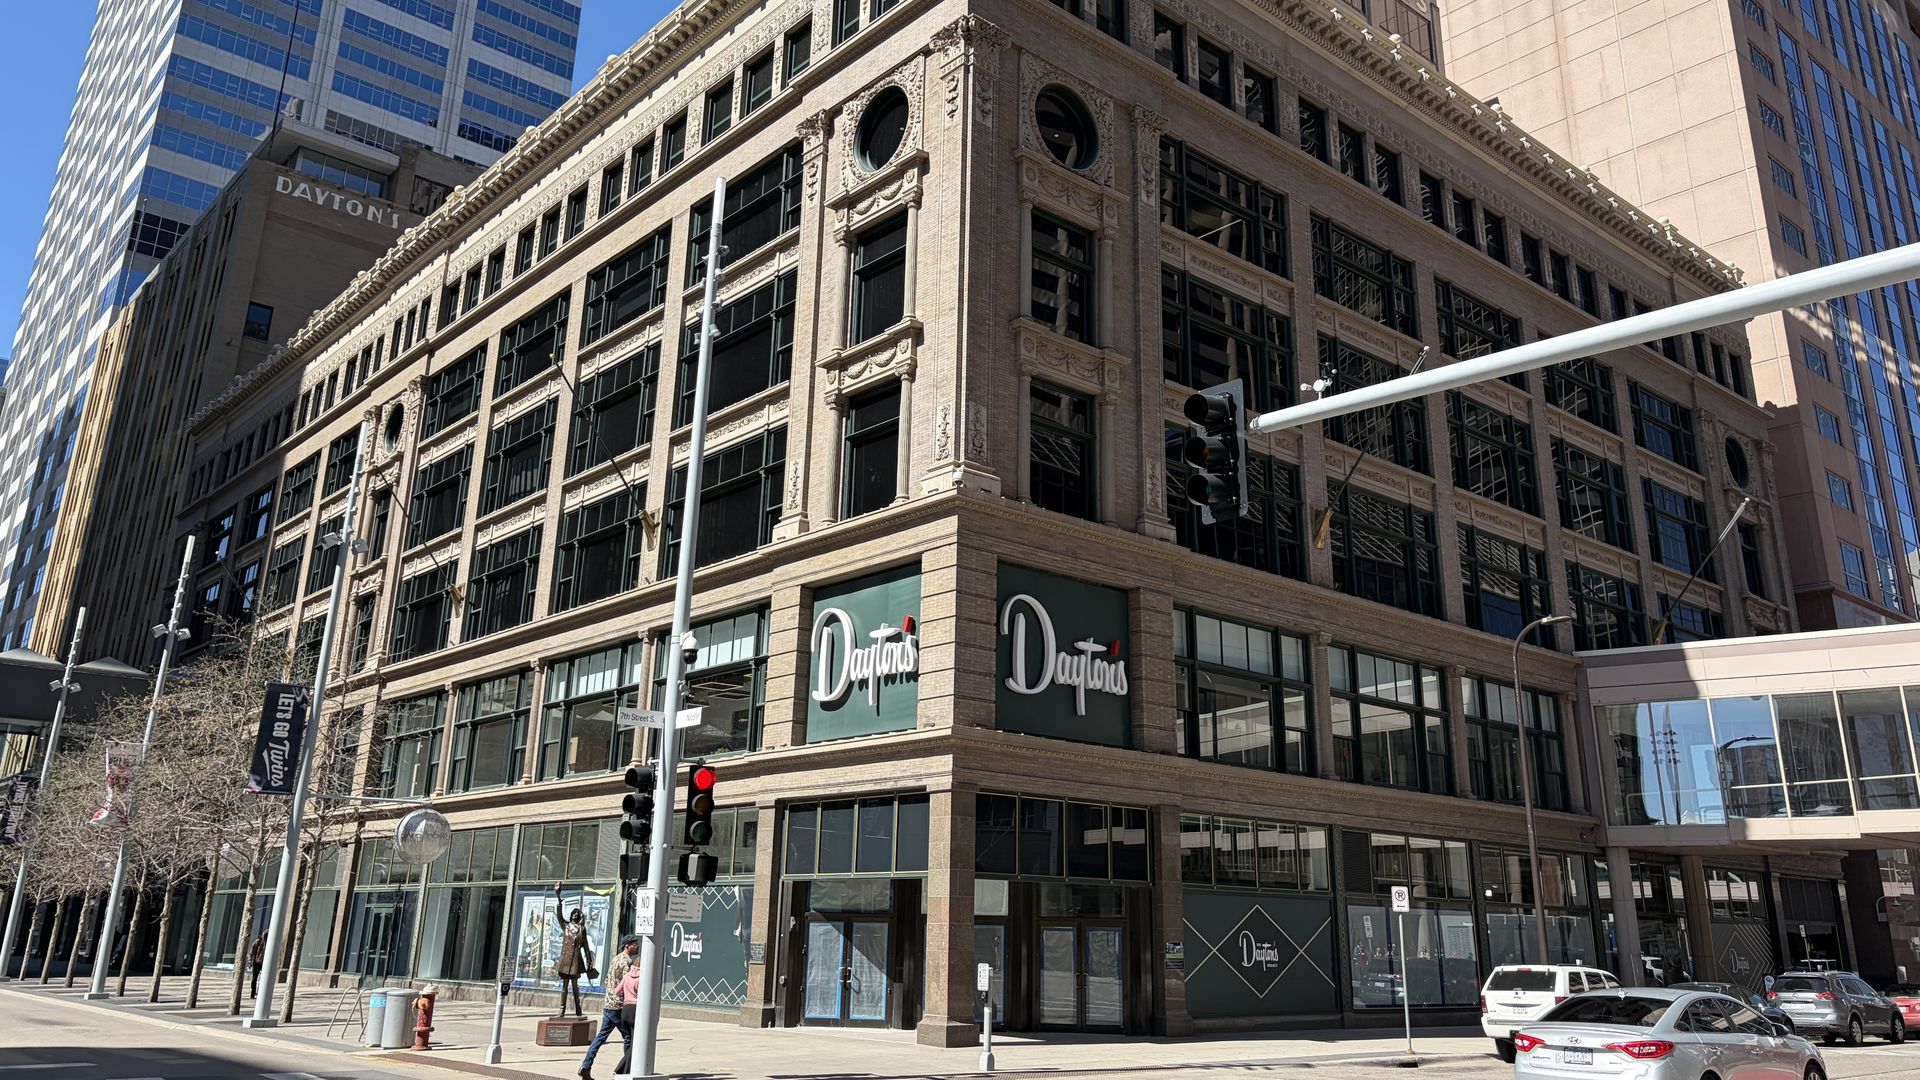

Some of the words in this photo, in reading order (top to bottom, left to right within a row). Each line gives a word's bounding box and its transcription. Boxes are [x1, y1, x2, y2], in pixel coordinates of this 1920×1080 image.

[275, 175, 400, 229] DAYTON'S
[811, 607, 919, 706] Dayton's
[1000, 594, 1128, 716] Dayton's
[275, 692, 295, 719] LET'S
[620, 711, 631, 720] 7th
[631, 713, 650, 723] Street
[272, 721, 291, 738] GO
[266, 739, 291, 787] Twins
[641, 896, 651, 909] NO
[637, 915, 654, 927] TURNS
